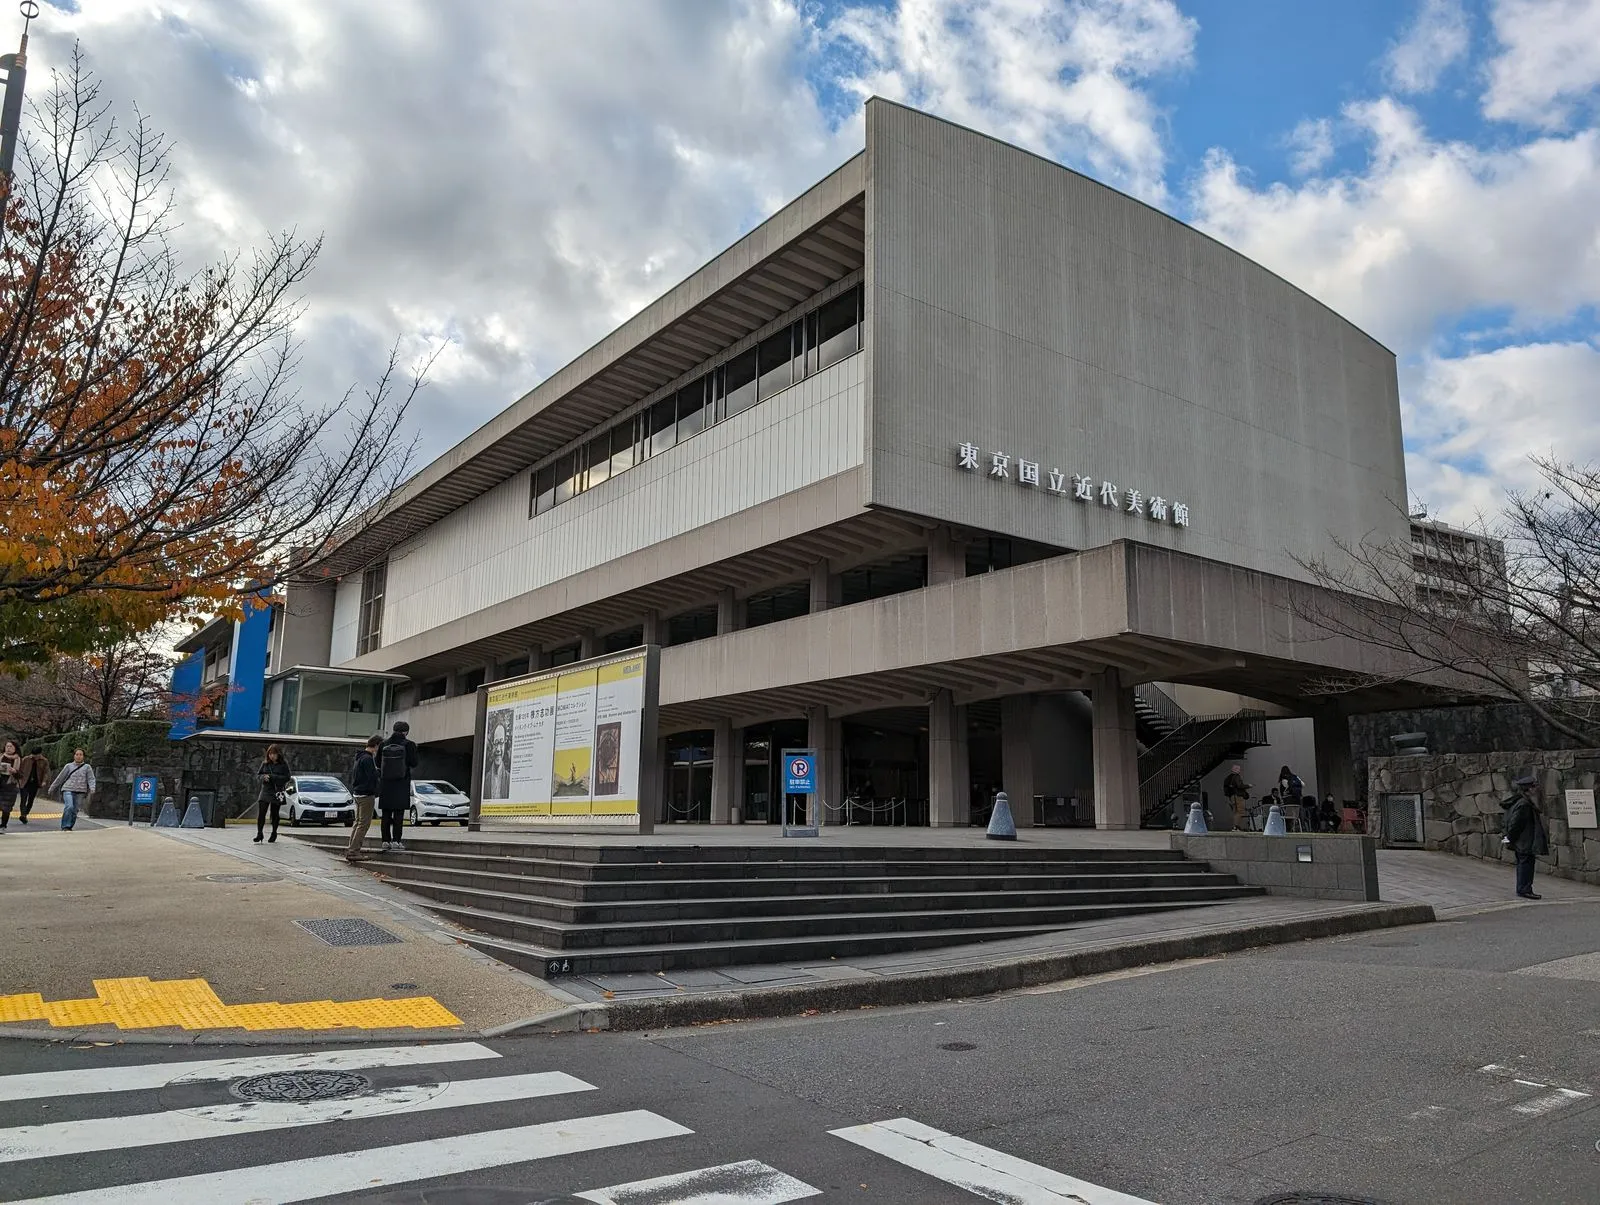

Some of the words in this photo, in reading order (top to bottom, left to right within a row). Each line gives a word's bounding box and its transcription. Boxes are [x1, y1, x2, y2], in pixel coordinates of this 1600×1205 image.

[957, 442, 1190, 528] 東京国立近代美術館
